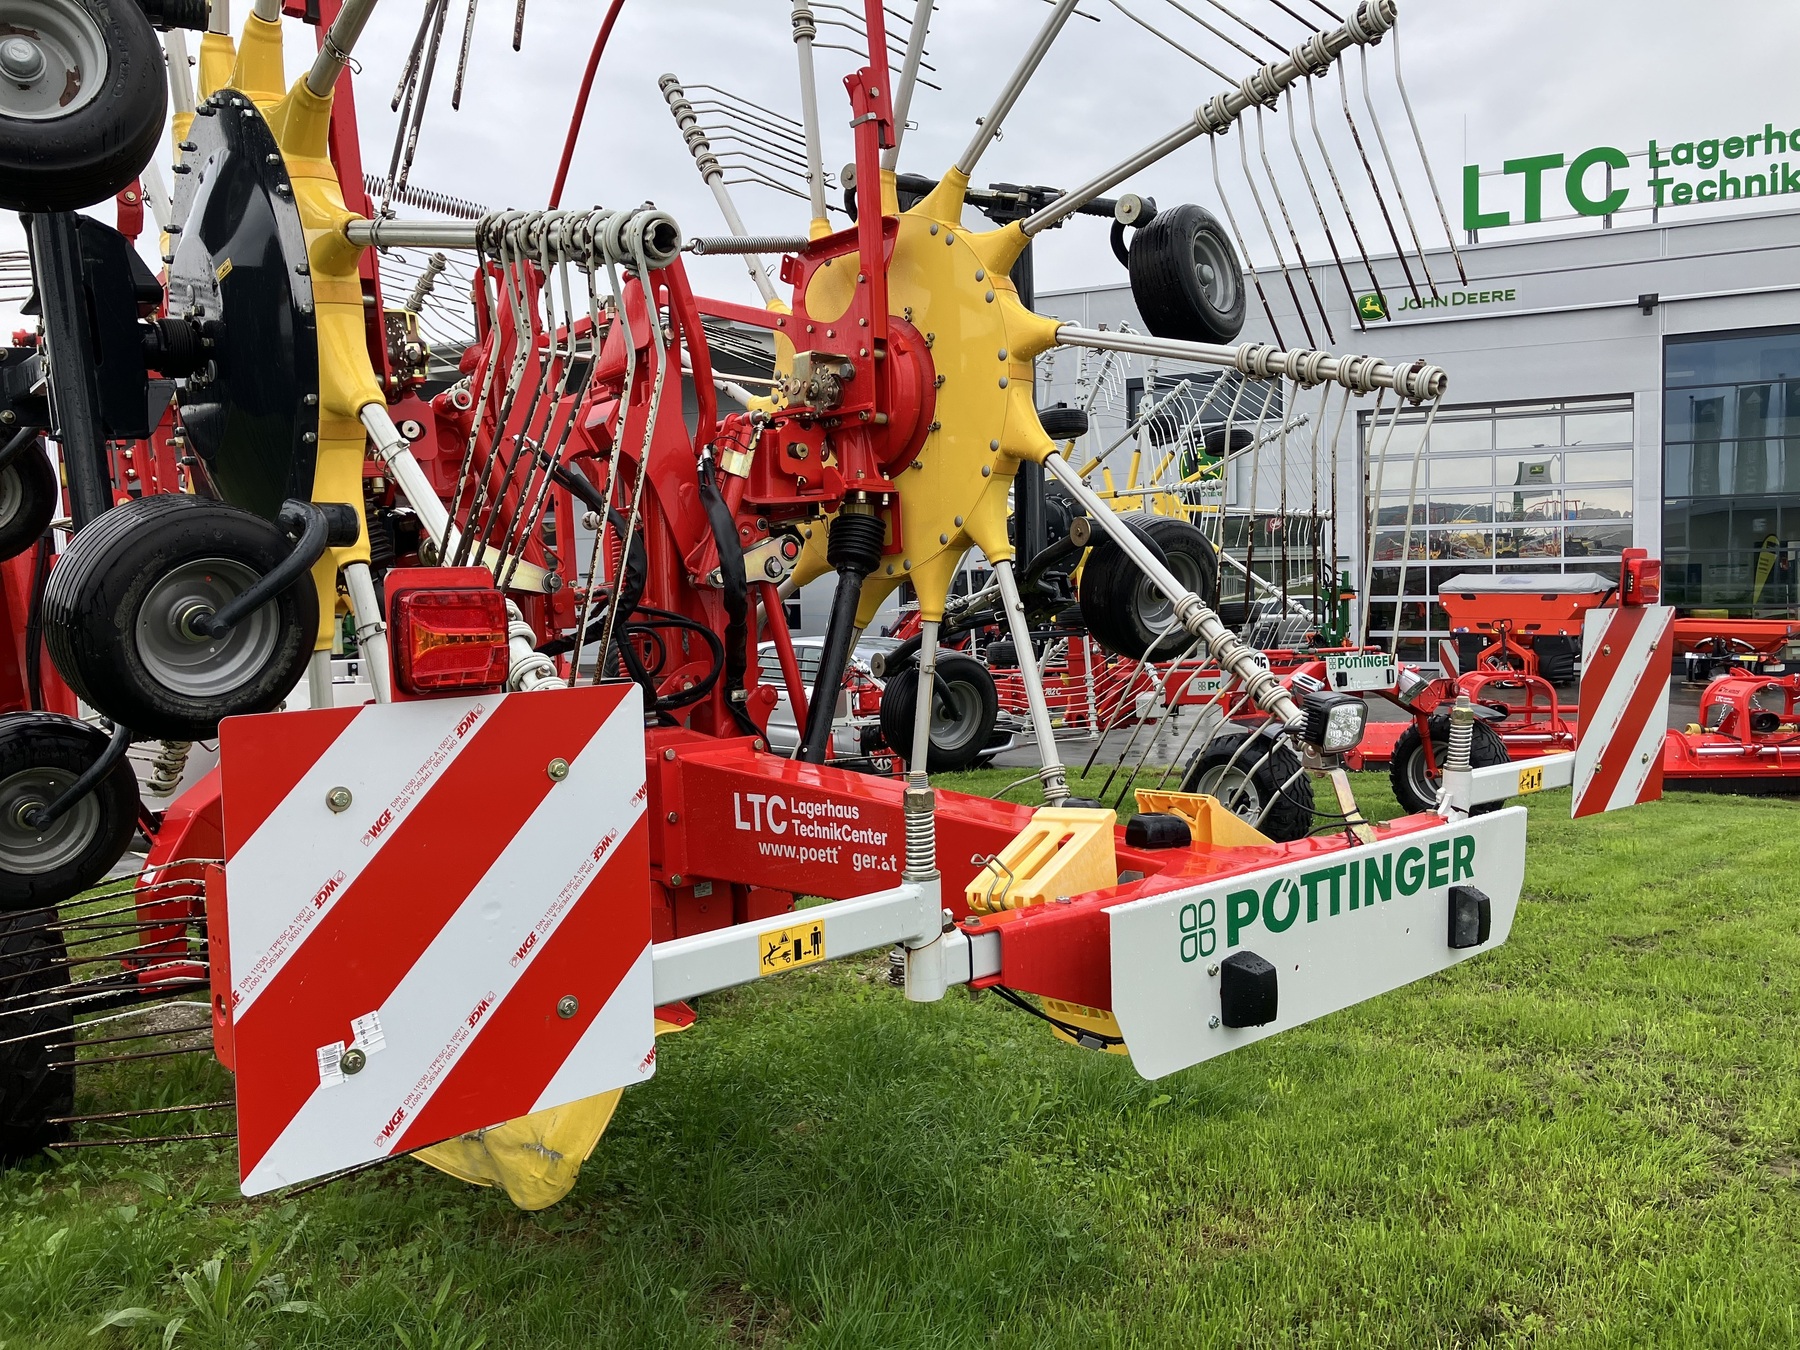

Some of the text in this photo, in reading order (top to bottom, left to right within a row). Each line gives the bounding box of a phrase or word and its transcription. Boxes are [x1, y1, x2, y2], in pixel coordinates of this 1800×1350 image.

[1463, 146, 1630, 231] LTC
[1398, 289, 1516, 311] JOHN DEERE
[457, 711, 478, 739] WGF
[446, 739, 458, 752] DIN
[390, 795, 402, 808] DIN
[401, 779, 416, 796] 11030
[416, 756, 435, 776] TPESC
[438, 734, 453, 751] 10071
[433, 751, 448, 768] 11030
[414, 770, 433, 791] TPESC
[394, 796, 411, 813] 10071
[734, 792, 788, 834] LTC
[791, 797, 860, 819] Lagerhaus
[368, 808, 391, 838] WGF
[792, 819, 888, 846] TechnikCenter
[593, 836, 612, 862] WGF
[315, 880, 338, 909] WGF
[1226, 834, 1476, 948] PÖTTINGER
[303, 910, 316, 924] DIN
[288, 924, 305, 942] 11030
[516, 931, 537, 959] WGF
[239, 975, 252, 989] DIN
[251, 956, 268, 975] 11030
[269, 930, 290, 952] TPESC
[293, 906, 310, 924] 10071
[266, 946, 287, 968] TPESC
[245, 974, 262, 994] 10071
[468, 999, 490, 1028] WGF
[459, 1030, 470, 1042] DIN
[445, 1043, 460, 1060] 11030
[403, 1092, 415, 1106] DIN
[414, 1074, 428, 1092] 11030
[429, 1049, 448, 1070] TPESC
[450, 1026, 465, 1043] 10071
[426, 1064, 445, 1086] TPESC
[408, 1092, 424, 1110] 10071
[381, 1106, 405, 1137] WGF
